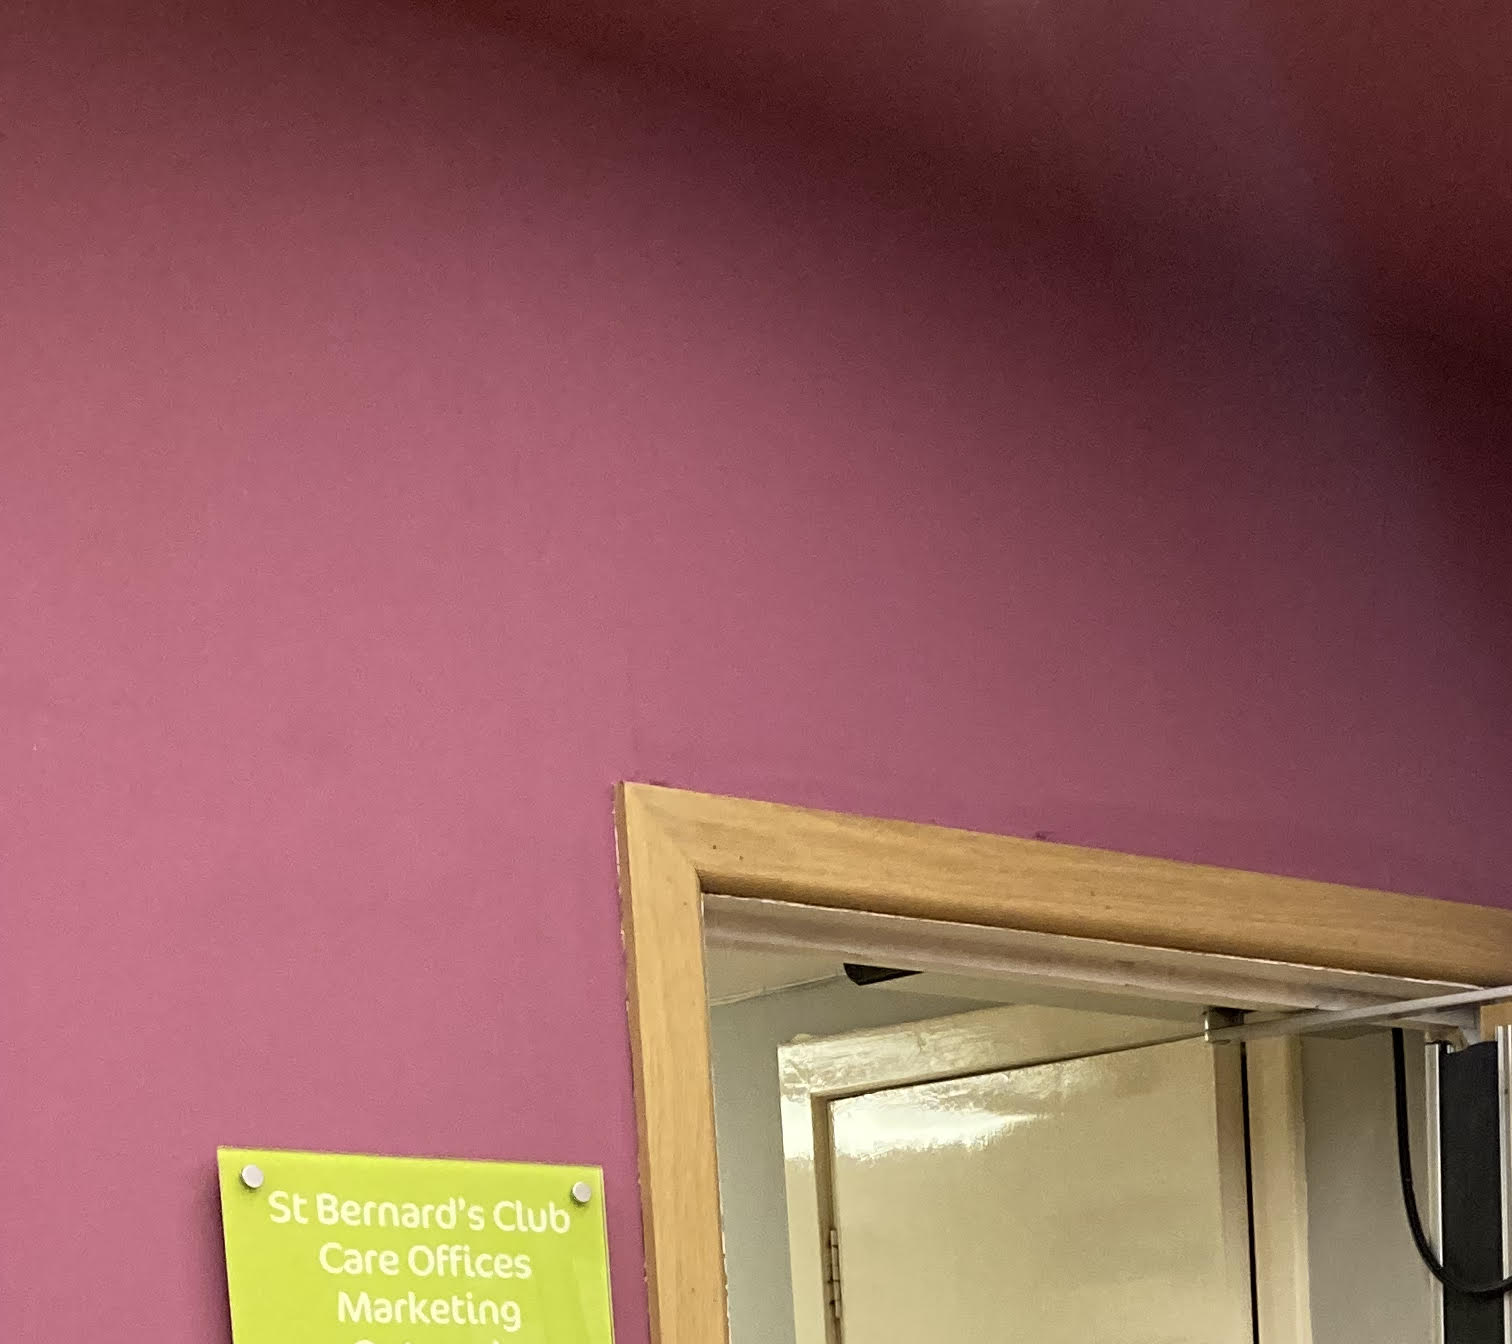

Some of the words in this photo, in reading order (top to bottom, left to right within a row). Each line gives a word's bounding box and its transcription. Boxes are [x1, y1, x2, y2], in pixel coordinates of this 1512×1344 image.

[268, 1191, 308, 1224] St
[315, 1193, 486, 1231] Bernard's
[493, 1200, 571, 1234] Club
[319, 1242, 399, 1276] Care
[408, 1244, 532, 1280] Offices
[337, 1291, 521, 1333] Marketing
